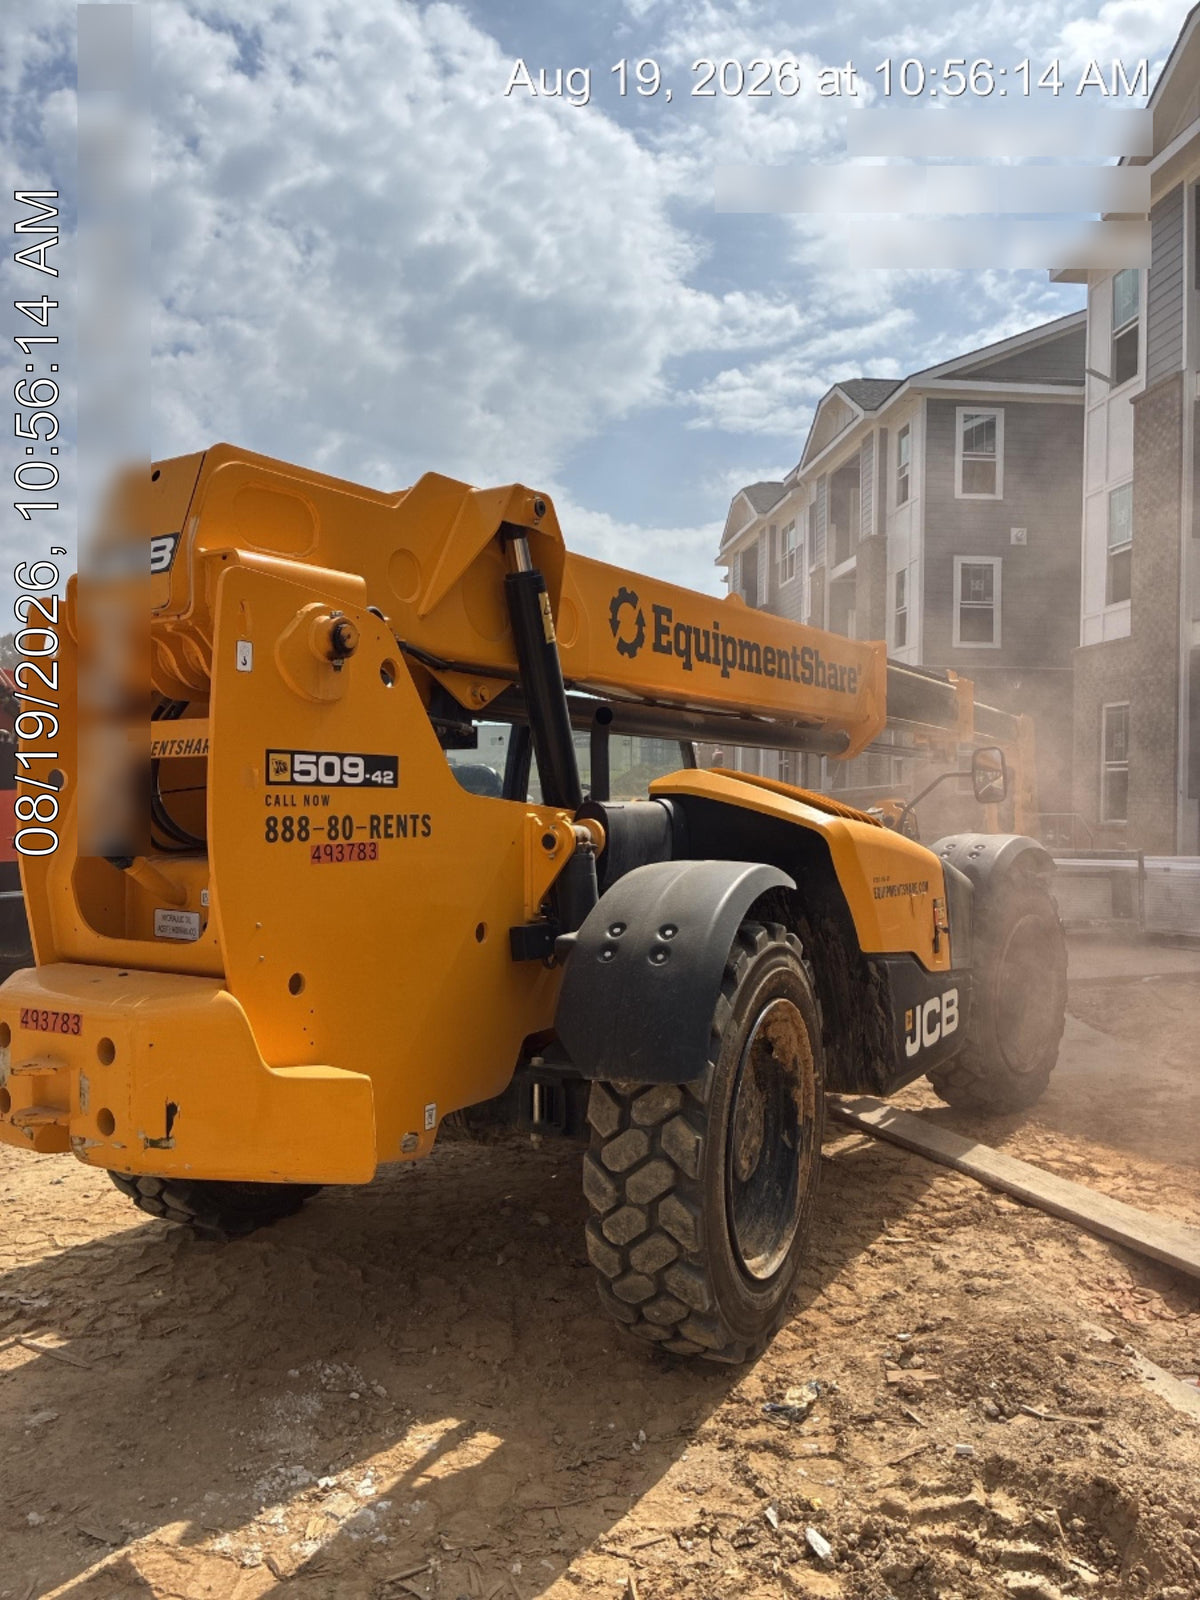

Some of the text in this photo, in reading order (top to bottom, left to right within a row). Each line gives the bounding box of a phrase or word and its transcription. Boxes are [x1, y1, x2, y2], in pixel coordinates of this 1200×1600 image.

[651, 604, 858, 694] EquipmentShare
[265, 794, 331, 807] CALL NOW
[265, 814, 432, 843] 888-80-RENTS
[311, 842, 378, 862] 493783
[20, 1009, 81, 1035] 493783
[905, 988, 960, 1057] JCB
